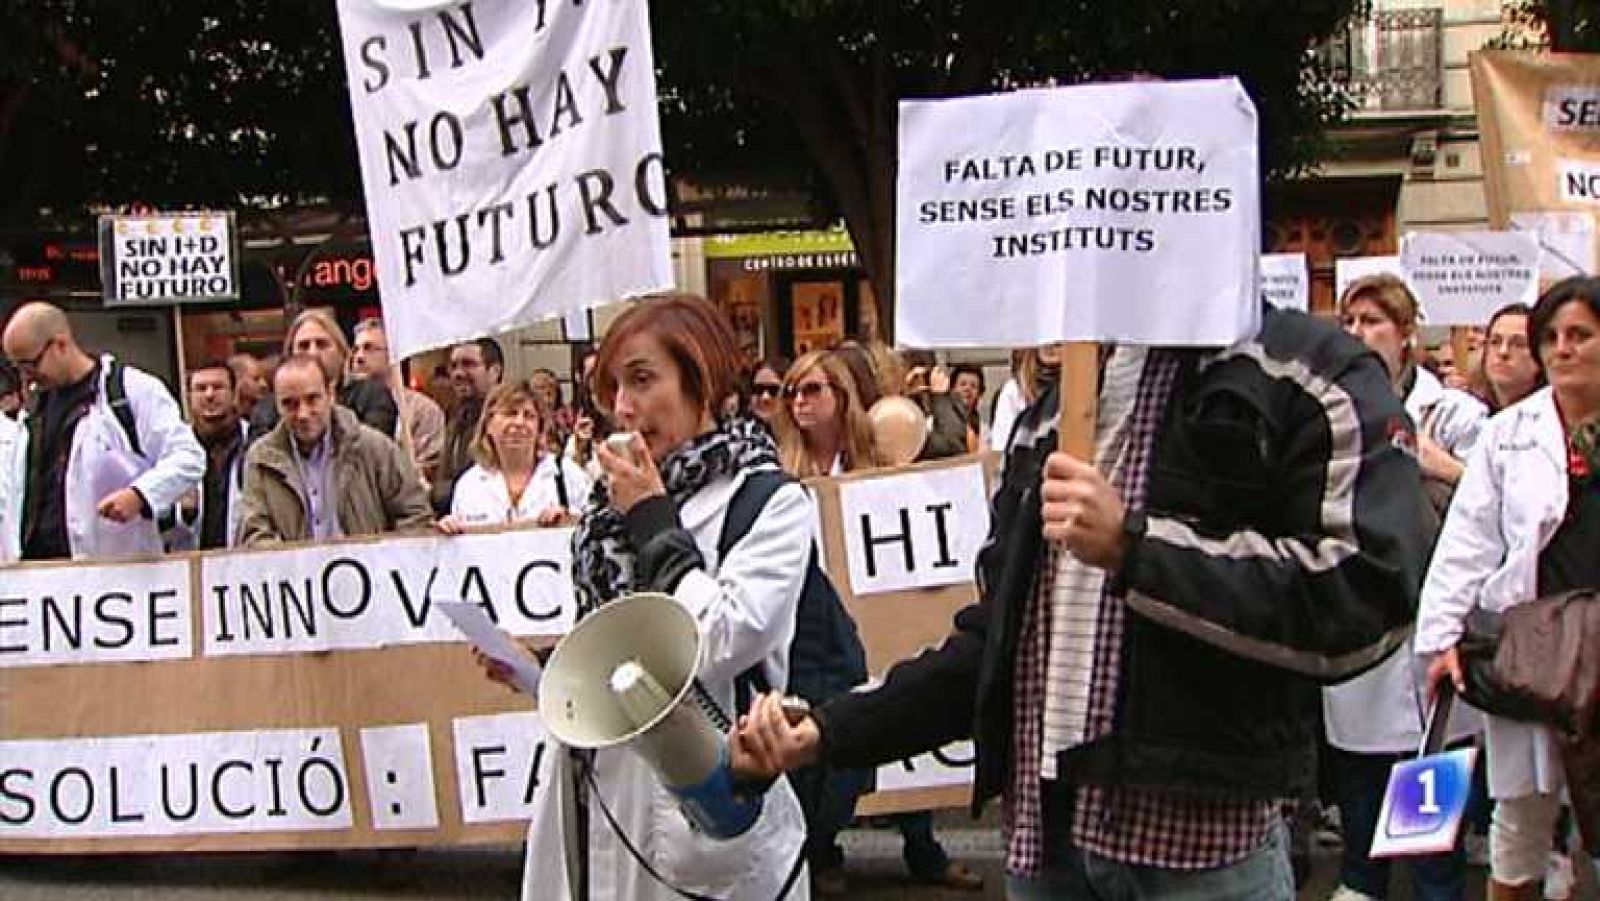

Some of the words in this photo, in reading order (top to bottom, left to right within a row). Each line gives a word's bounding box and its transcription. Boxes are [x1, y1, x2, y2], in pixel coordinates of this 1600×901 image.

[360, 2, 485, 94] SIN
[383, 110, 464, 187] NO
[489, 46, 628, 157] HAY
[944, 154, 1036, 184] FALTA
[1045, 149, 1083, 172] DE
[1095, 146, 1206, 174] FUTUR,
[919, 197, 1016, 224] SENSE
[1027, 193, 1075, 219] ELS
[1086, 187, 1233, 214] NOSTRES
[124, 238, 167, 258] SIN
[174, 236, 218, 255] I+D
[992, 227, 1155, 258] INSTITUTS
[120, 259, 162, 277] NO
[169, 255, 226, 276] HAY
[120, 276, 228, 301] FUTURO
[860, 501, 958, 578] HI
[0, 737, 345, 825] SOLUCIÓ
